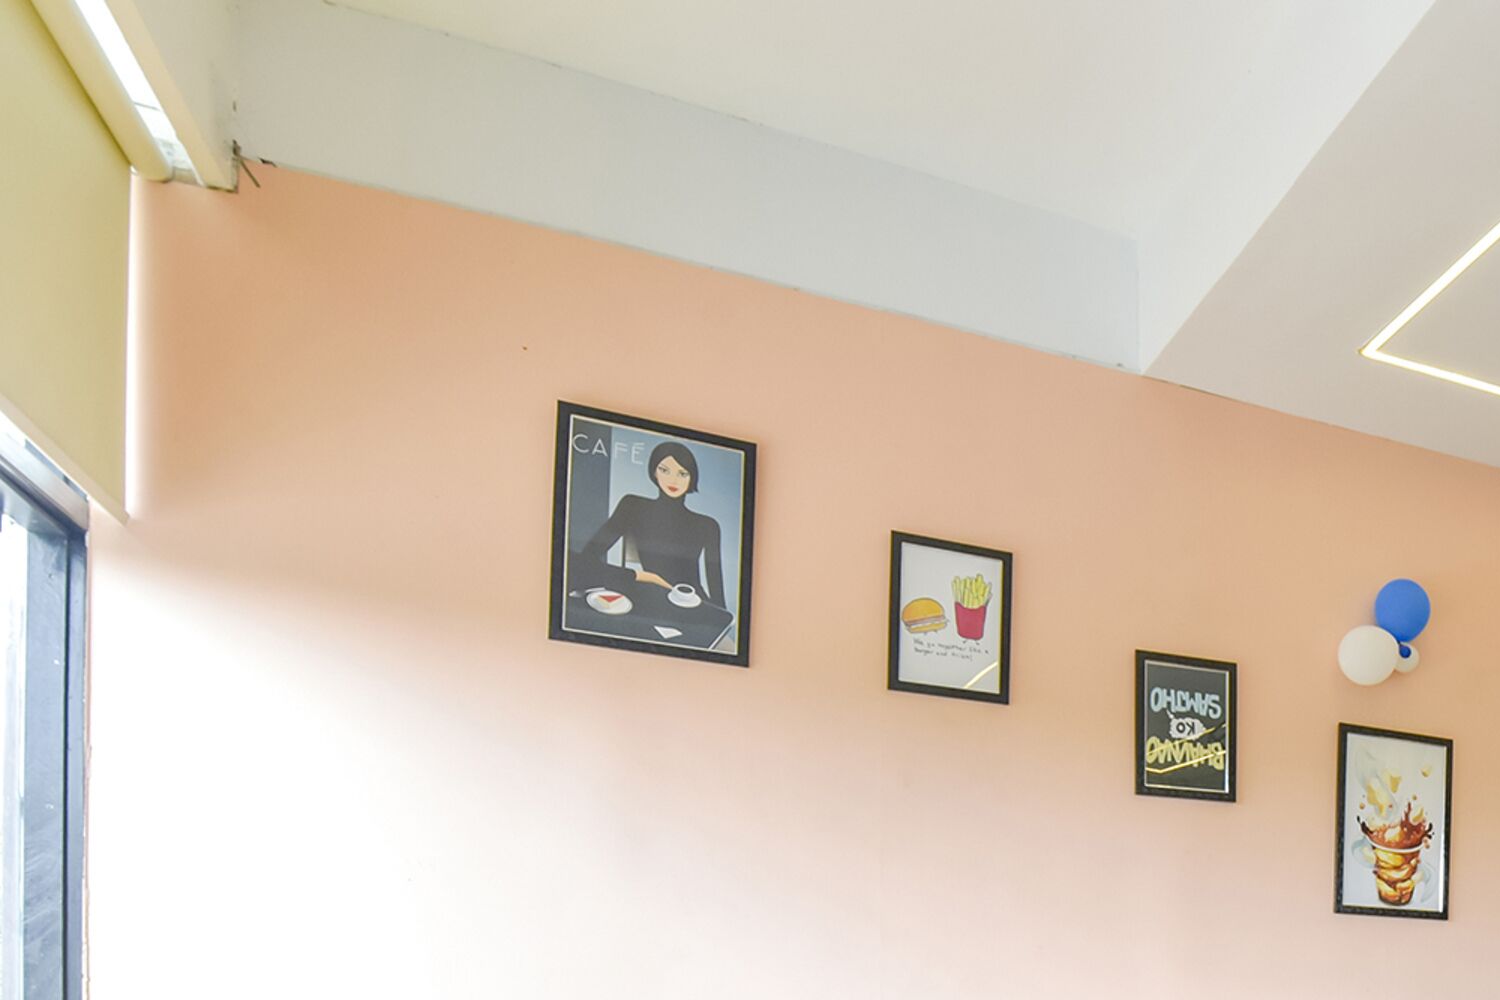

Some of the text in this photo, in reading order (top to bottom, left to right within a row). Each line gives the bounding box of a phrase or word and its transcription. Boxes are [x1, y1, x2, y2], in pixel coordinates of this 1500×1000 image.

[572, 433, 646, 466] CAFÉ
[1150, 687, 1222, 719] SAMJHO
[1176, 721, 1195, 736] KO
